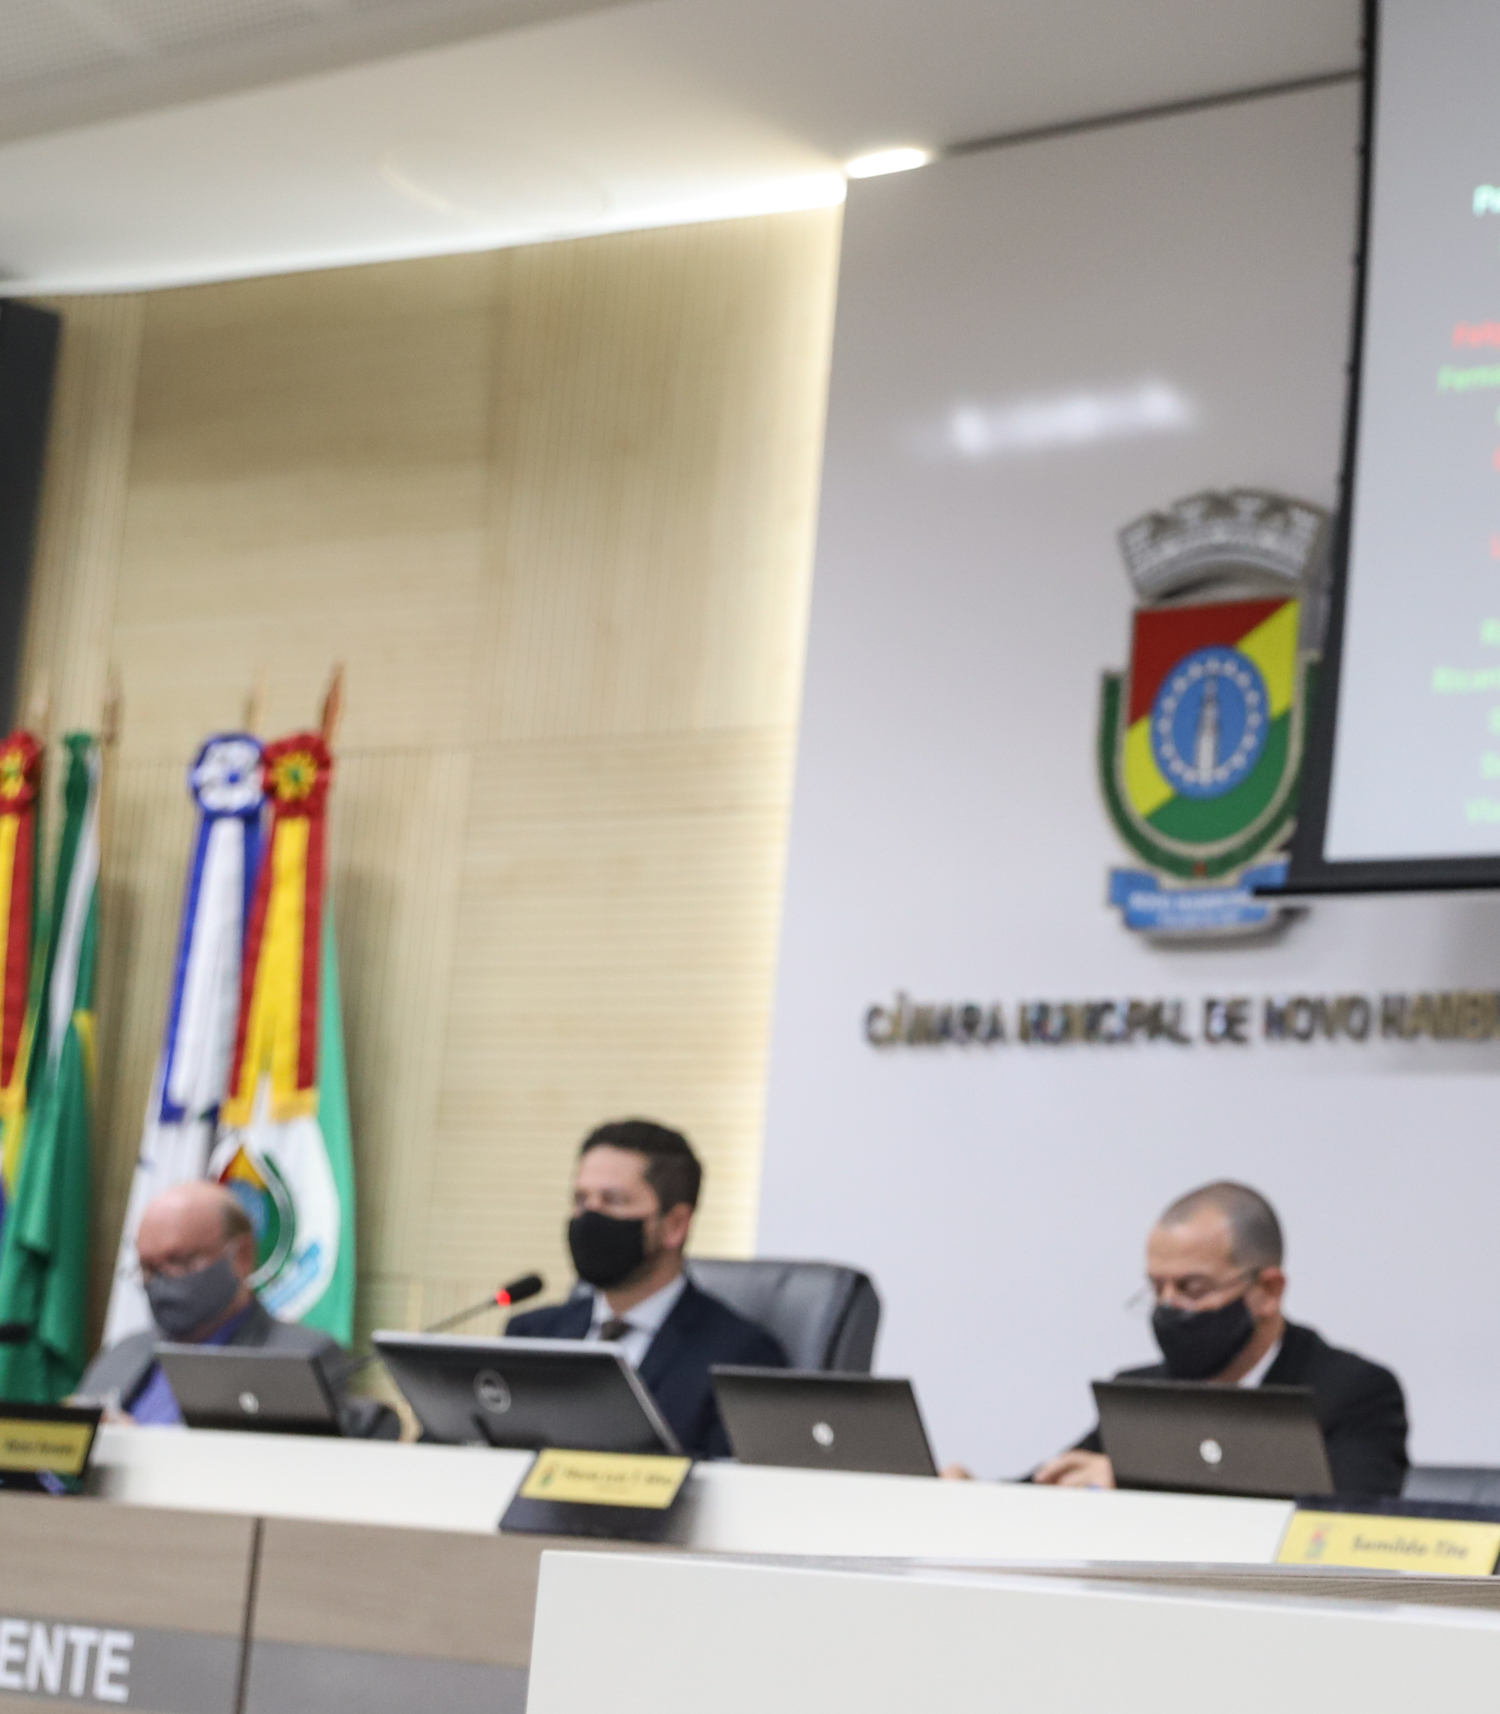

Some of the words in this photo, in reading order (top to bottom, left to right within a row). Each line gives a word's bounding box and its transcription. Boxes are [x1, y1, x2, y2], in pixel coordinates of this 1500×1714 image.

[866, 990, 1006, 1046] CÂMARA
[1019, 999, 1191, 1046] MUNICIPAL
[1205, 998, 1250, 1044] DE
[1264, 994, 1372, 1042] NOVO
[0, 1617, 135, 1704] ENTE
